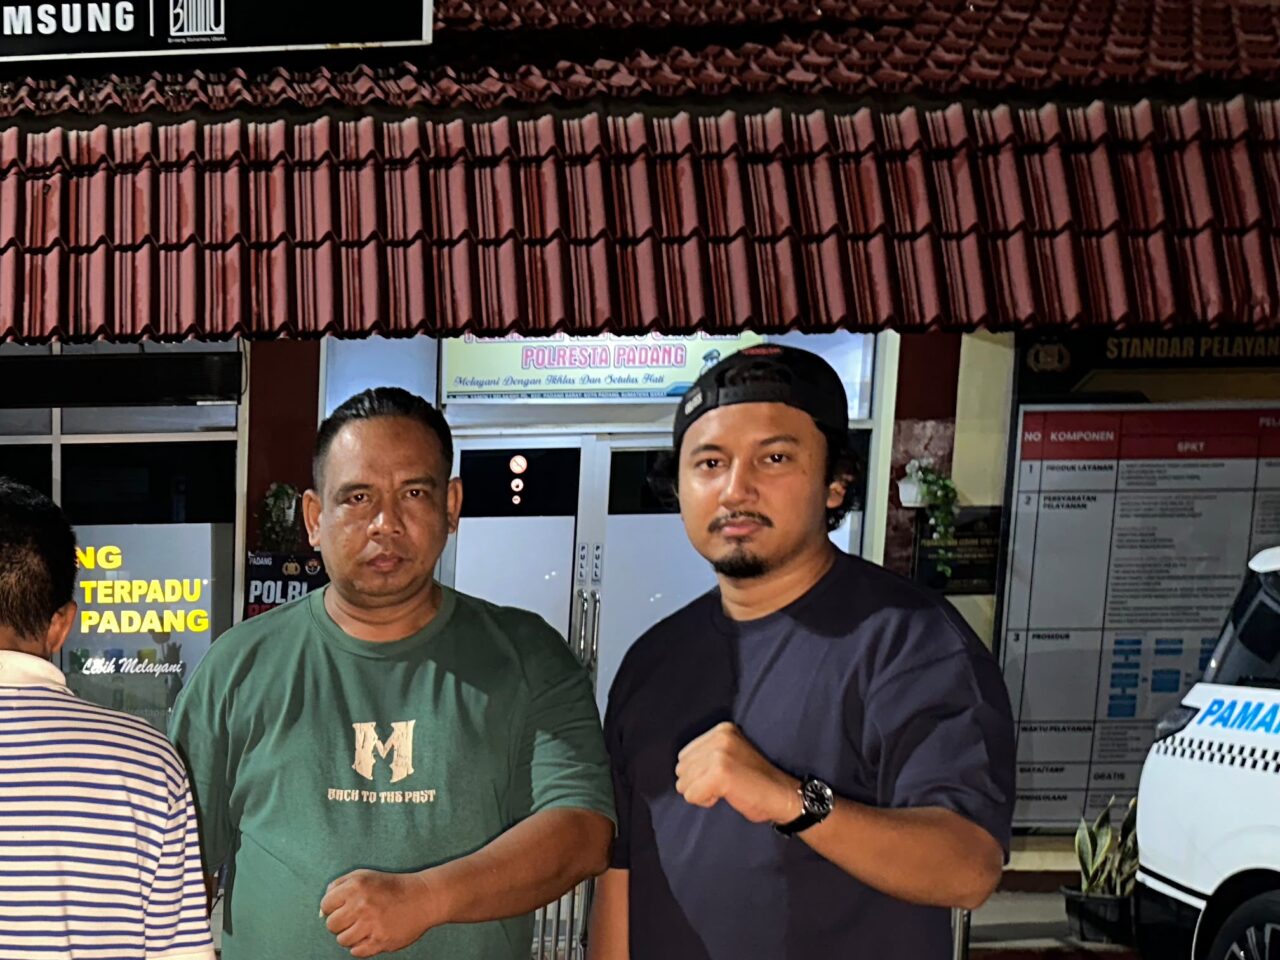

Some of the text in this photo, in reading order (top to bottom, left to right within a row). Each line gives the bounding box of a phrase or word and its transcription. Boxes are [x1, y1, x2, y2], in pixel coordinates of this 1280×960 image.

[522, 343, 687, 369] POLRESTA PADANG
[1106, 336, 1195, 359] STANDAR
[503, 375, 541, 388] Dengan
[580, 374, 601, 385] Dan
[1024, 432, 1042, 442] NO
[1050, 431, 1115, 442] KOMPONEN
[79, 578, 201, 604] TERPADU
[81, 609, 209, 634] PADANG
[120, 657, 183, 678] Melayani
[352, 719, 416, 783] M
[361, 790, 377, 803] TO
